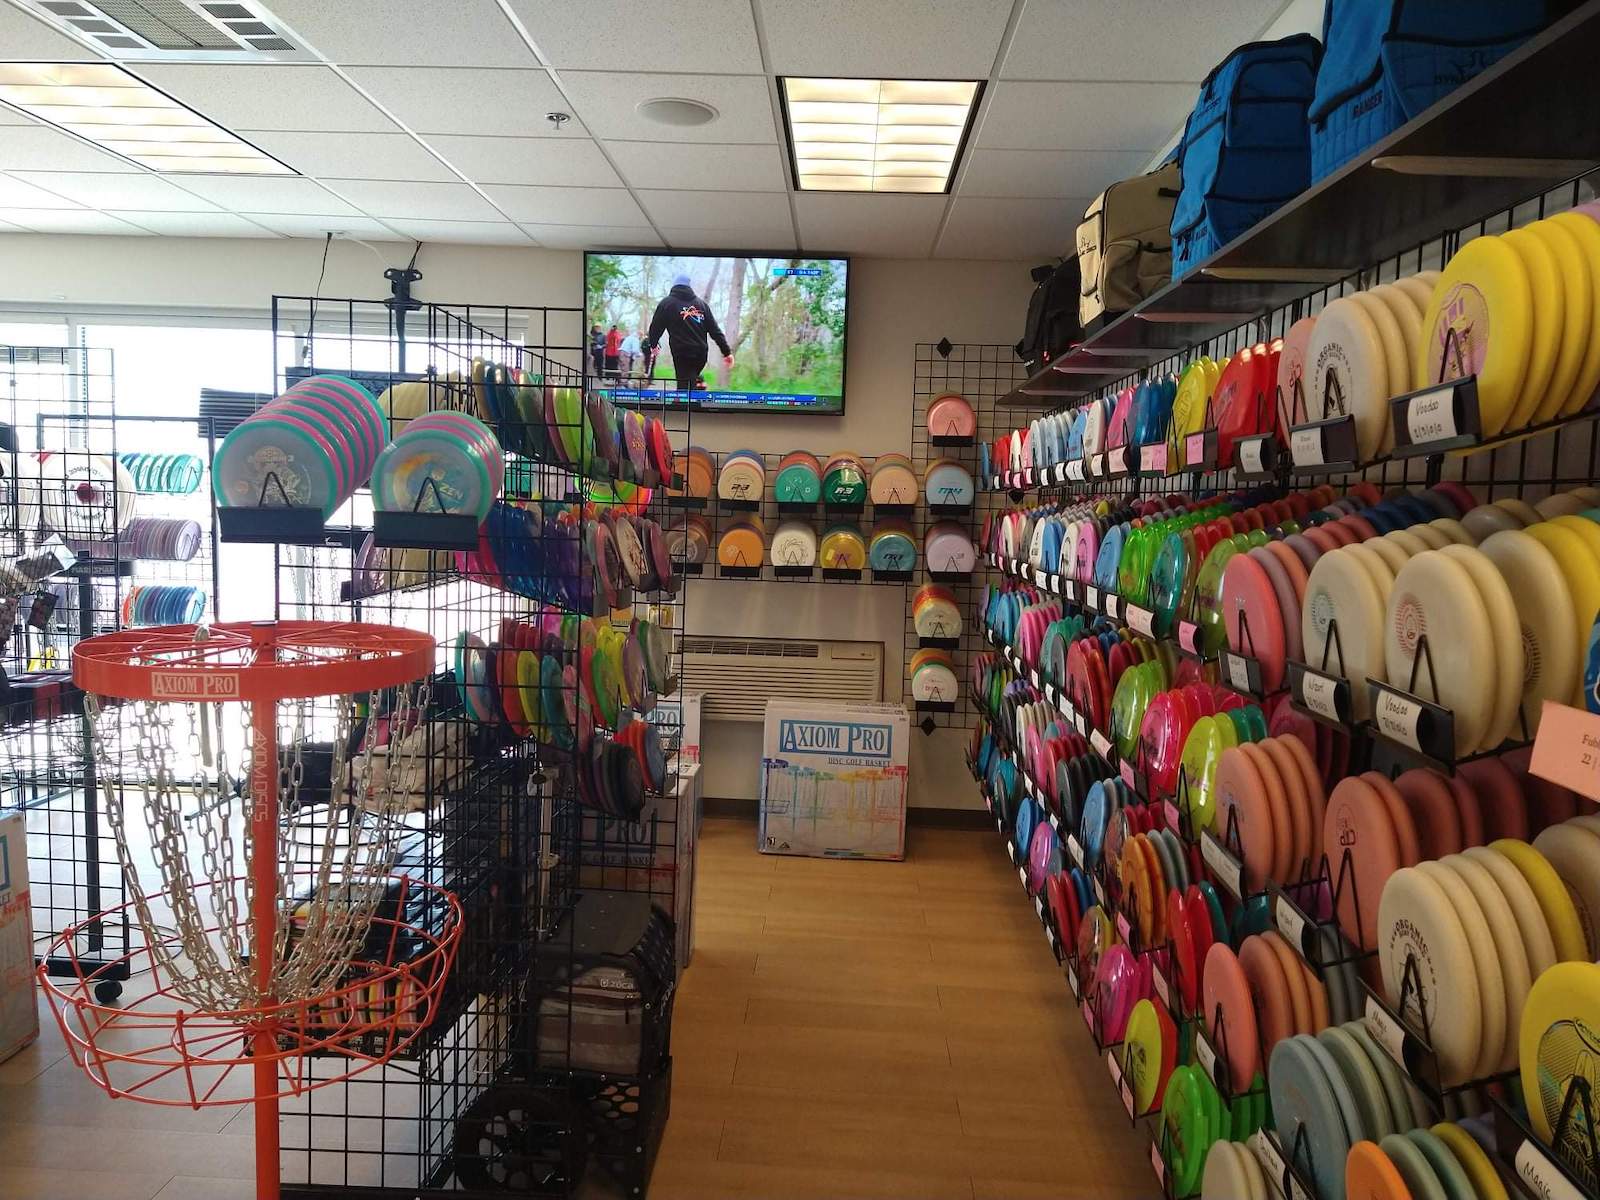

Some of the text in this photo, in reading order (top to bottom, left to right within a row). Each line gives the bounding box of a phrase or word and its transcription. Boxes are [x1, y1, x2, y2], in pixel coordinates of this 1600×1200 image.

[1415, 399, 1440, 416] Voodoo
[152, 673, 234, 696] AXIOM PRO
[1385, 695, 1409, 716] Voodoo
[784, 723, 886, 752] AXIOM PRO
[828, 757, 891, 768] DISC GOLF BASKET
